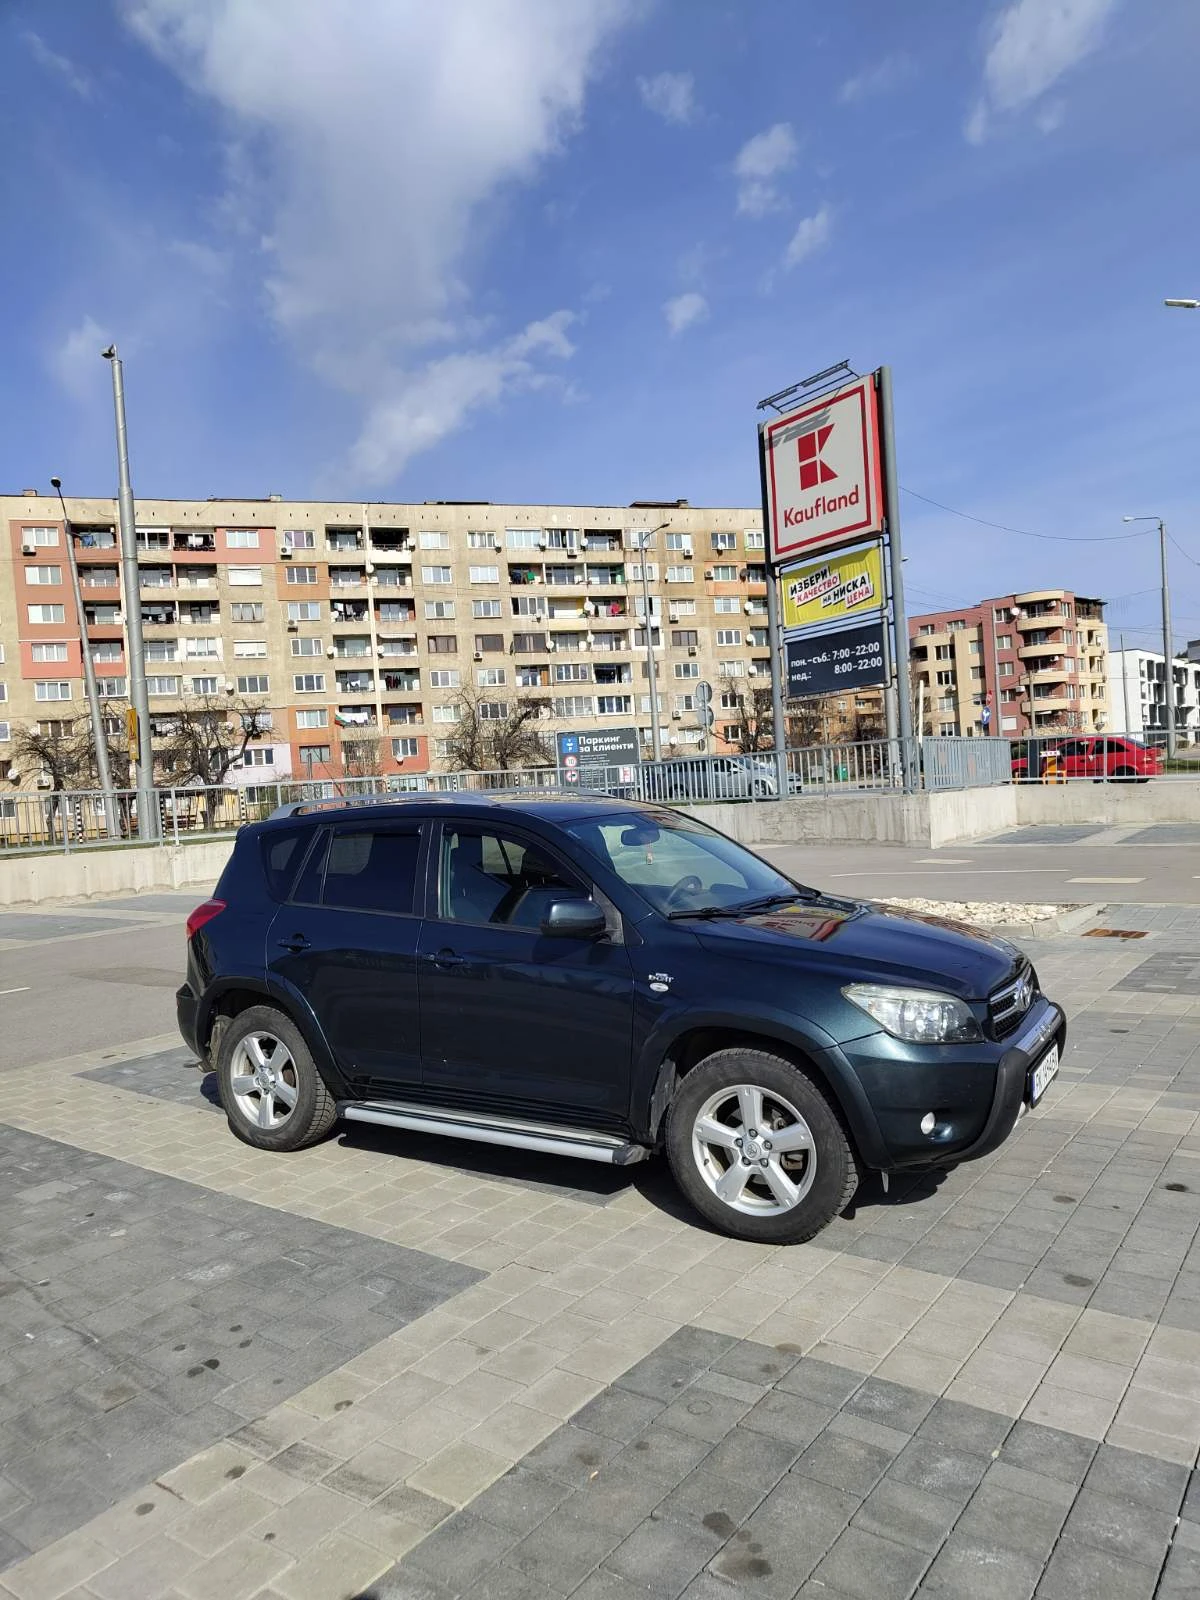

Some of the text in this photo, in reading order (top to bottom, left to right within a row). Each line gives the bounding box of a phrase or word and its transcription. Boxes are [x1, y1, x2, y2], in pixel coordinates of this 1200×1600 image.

[783, 484, 859, 528] Kaufland
[790, 568, 828, 596] ИЗБЕРИ
[796, 575, 839, 603] КАЧЕСТВО
[833, 575, 867, 600] НИСКА
[846, 586, 871, 605] ЦЕНА
[579, 736, 620, 746] Паркинг
[593, 743, 633, 752] клиенти
